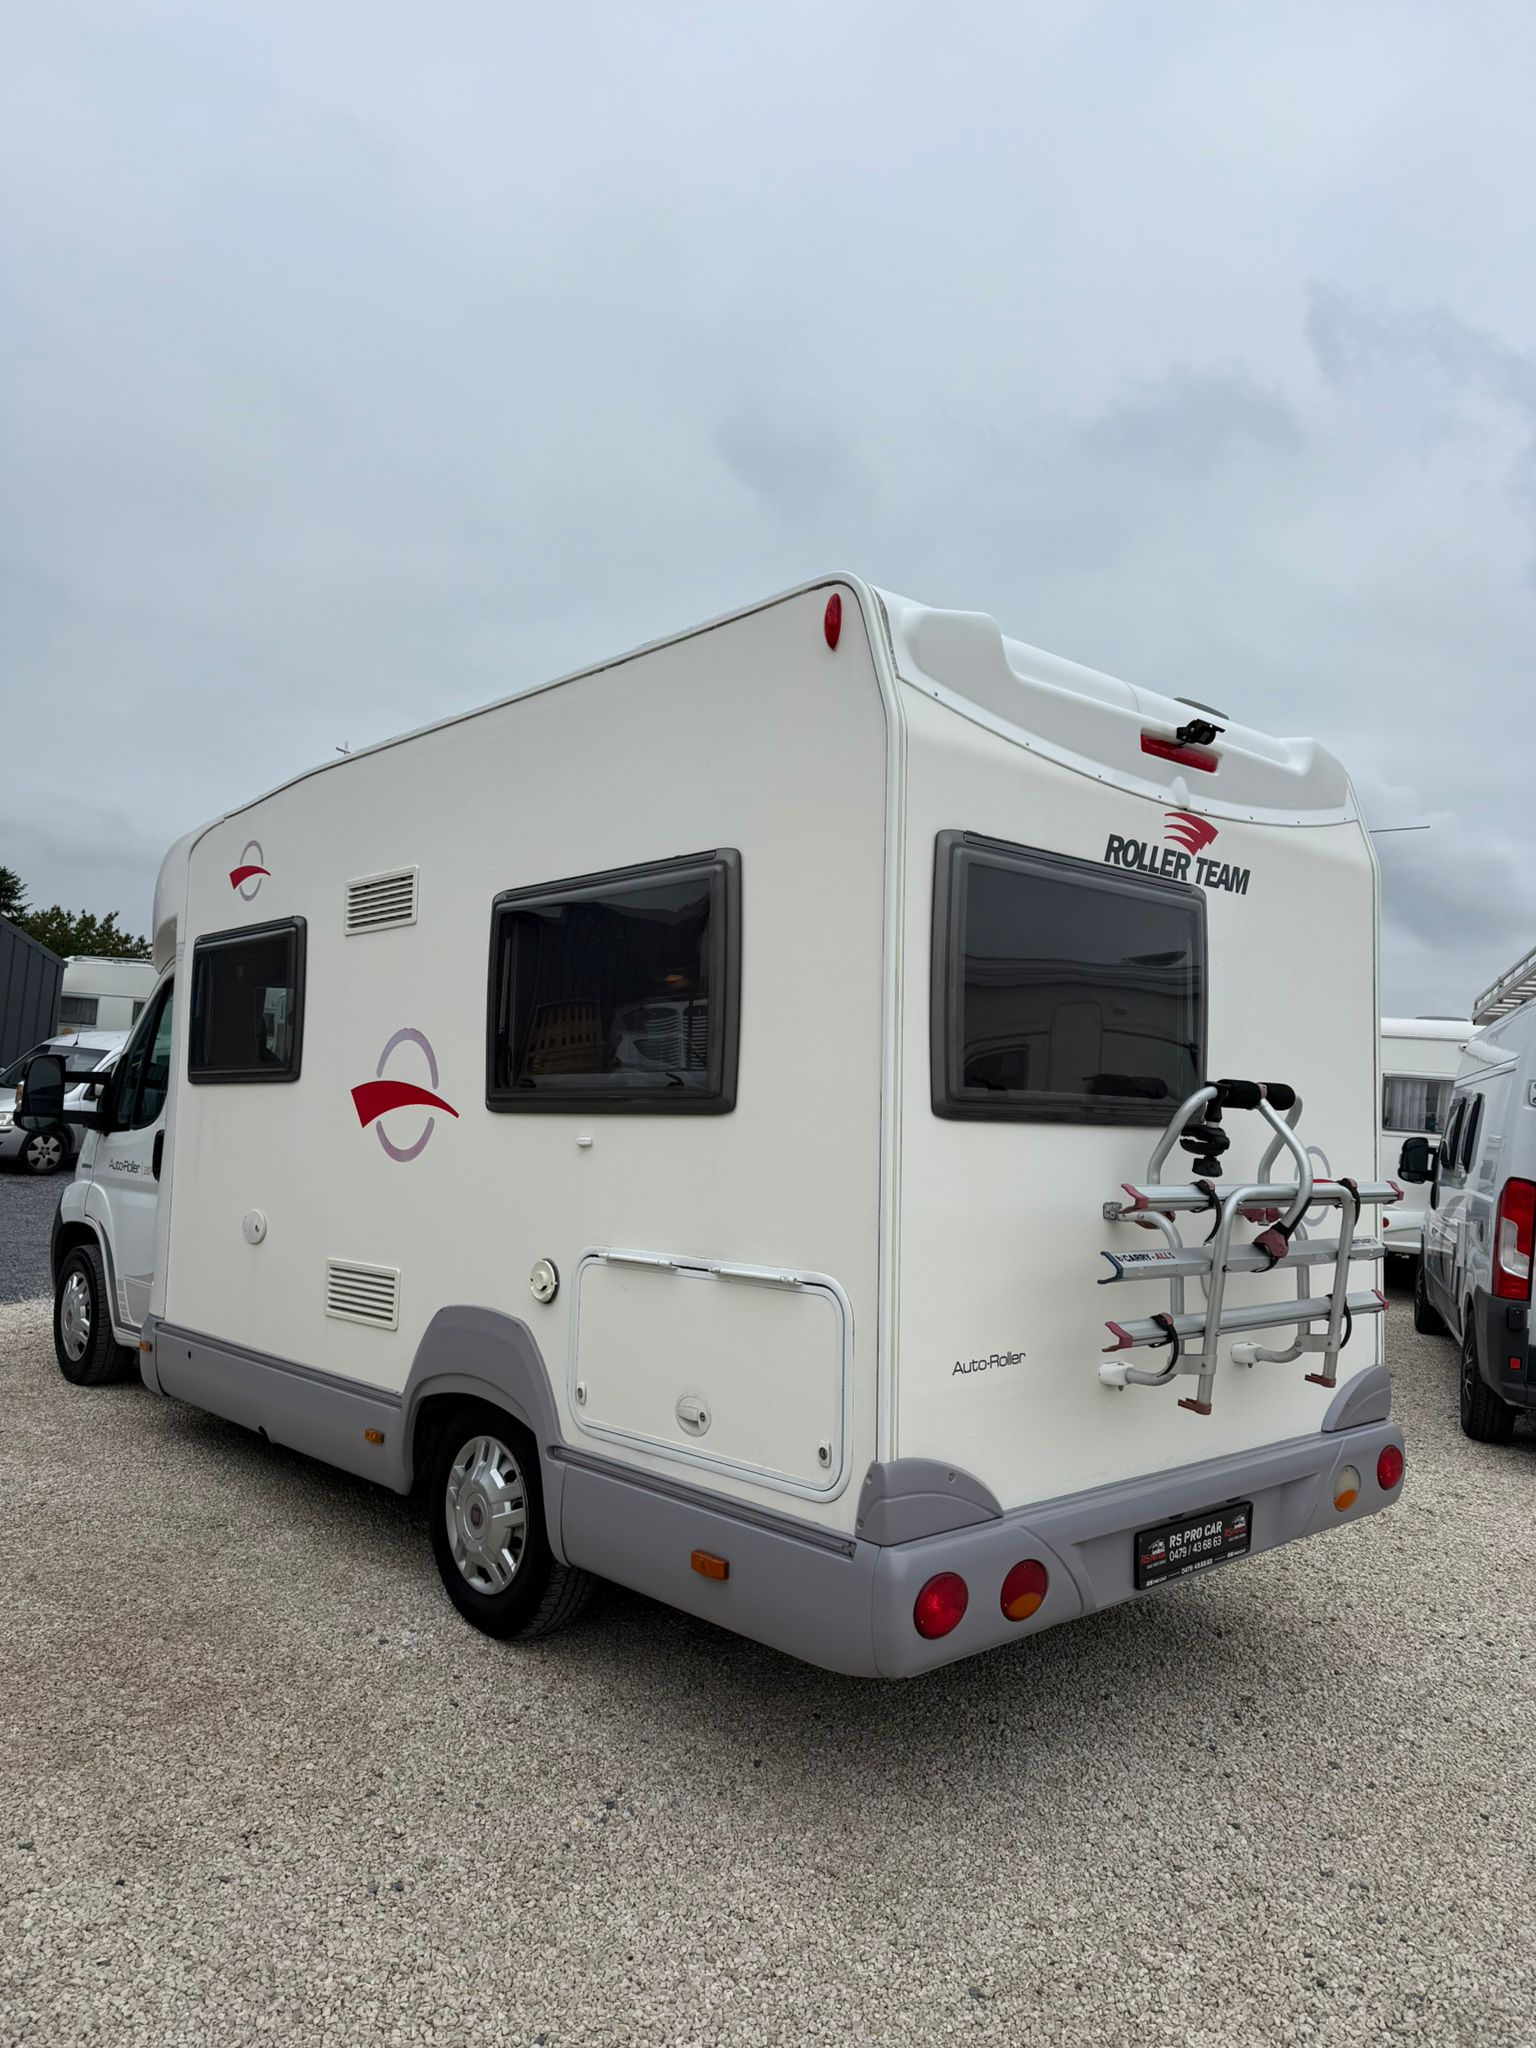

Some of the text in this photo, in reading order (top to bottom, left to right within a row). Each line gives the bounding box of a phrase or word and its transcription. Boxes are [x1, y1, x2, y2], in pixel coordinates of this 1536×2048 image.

[1104, 833, 1251, 895] ROLLER TEAM
[1169, 1533, 1183, 1548] RS
[1183, 1526, 1203, 1544] PRO
[1204, 1520, 1223, 1537] CAR
[1169, 1546, 1187, 1562] 0479
[1192, 1541, 1202, 1553] 43
[1202, 1538, 1212, 1550] 68
[1212, 1535, 1222, 1547] 63
